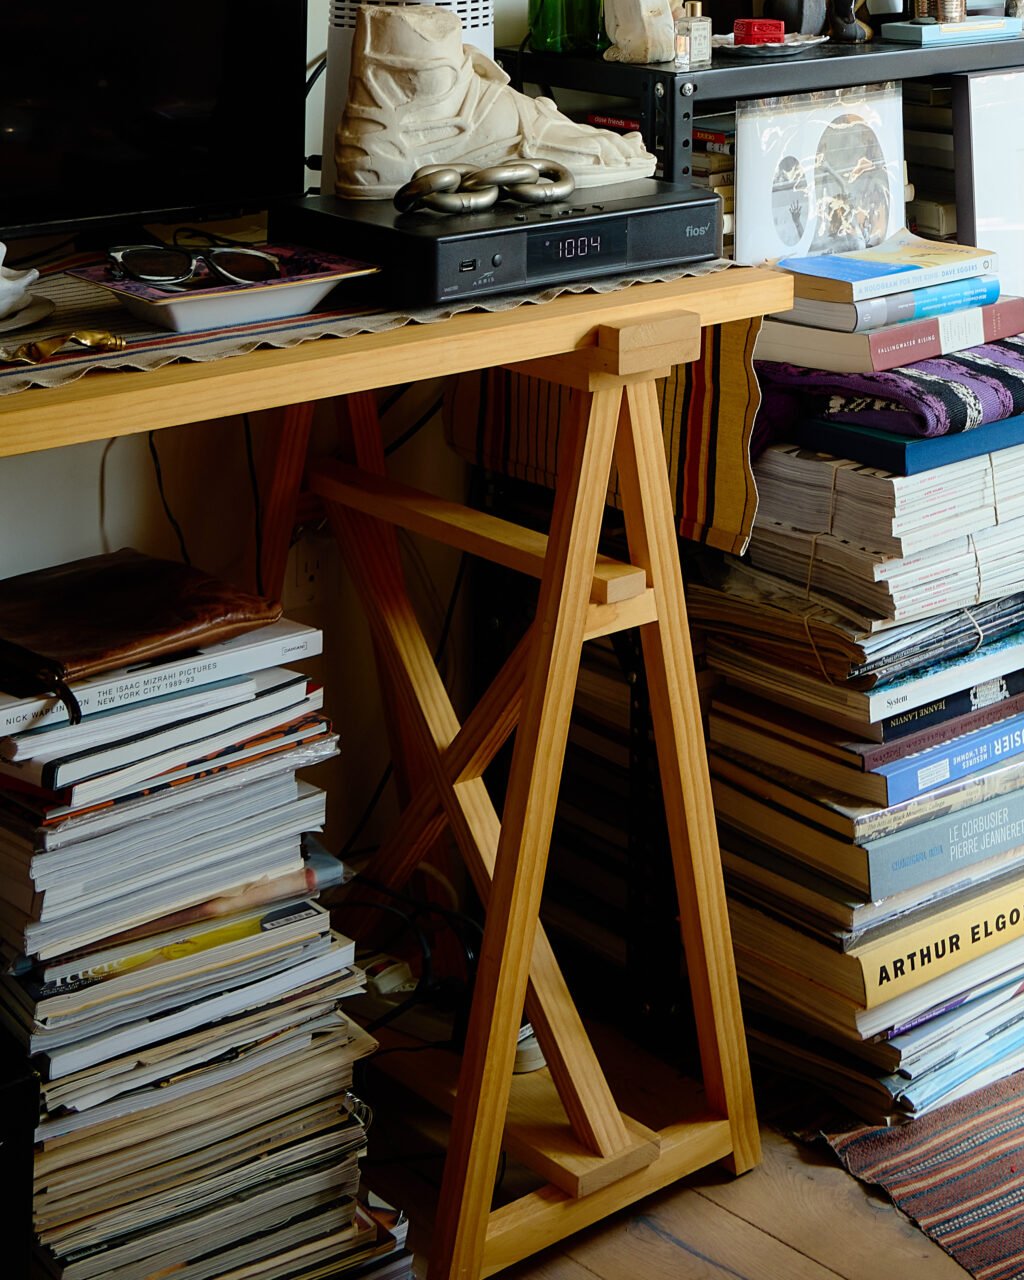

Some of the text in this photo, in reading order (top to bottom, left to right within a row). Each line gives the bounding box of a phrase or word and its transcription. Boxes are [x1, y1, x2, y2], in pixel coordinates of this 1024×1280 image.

[685, 224, 706, 237] fios
[558, 236, 600, 258] 1004
[864, 280, 900, 293] HOLOGRAM
[941, 268, 956, 278] DAVE
[957, 263, 978, 275] EGGERS
[878, 334, 936, 354] FALLINGWATER RISING
[97, 663, 218, 698] THE ISAAC MIZRAHI PICTURES
[97, 676, 196, 707] NEW YORK CITY 1989-93
[6, 698, 90, 726] NICK WAPLINON
[886, 694, 908, 709] System
[890, 699, 946, 727] JEANNE LANVIN
[962, 753, 988, 770] MESURES
[979, 745, 987, 755] DE
[949, 808, 1009, 843] LE CORBUSIER
[950, 841, 978, 862] PIERRE
[878, 933, 961, 986] ARTHUR
